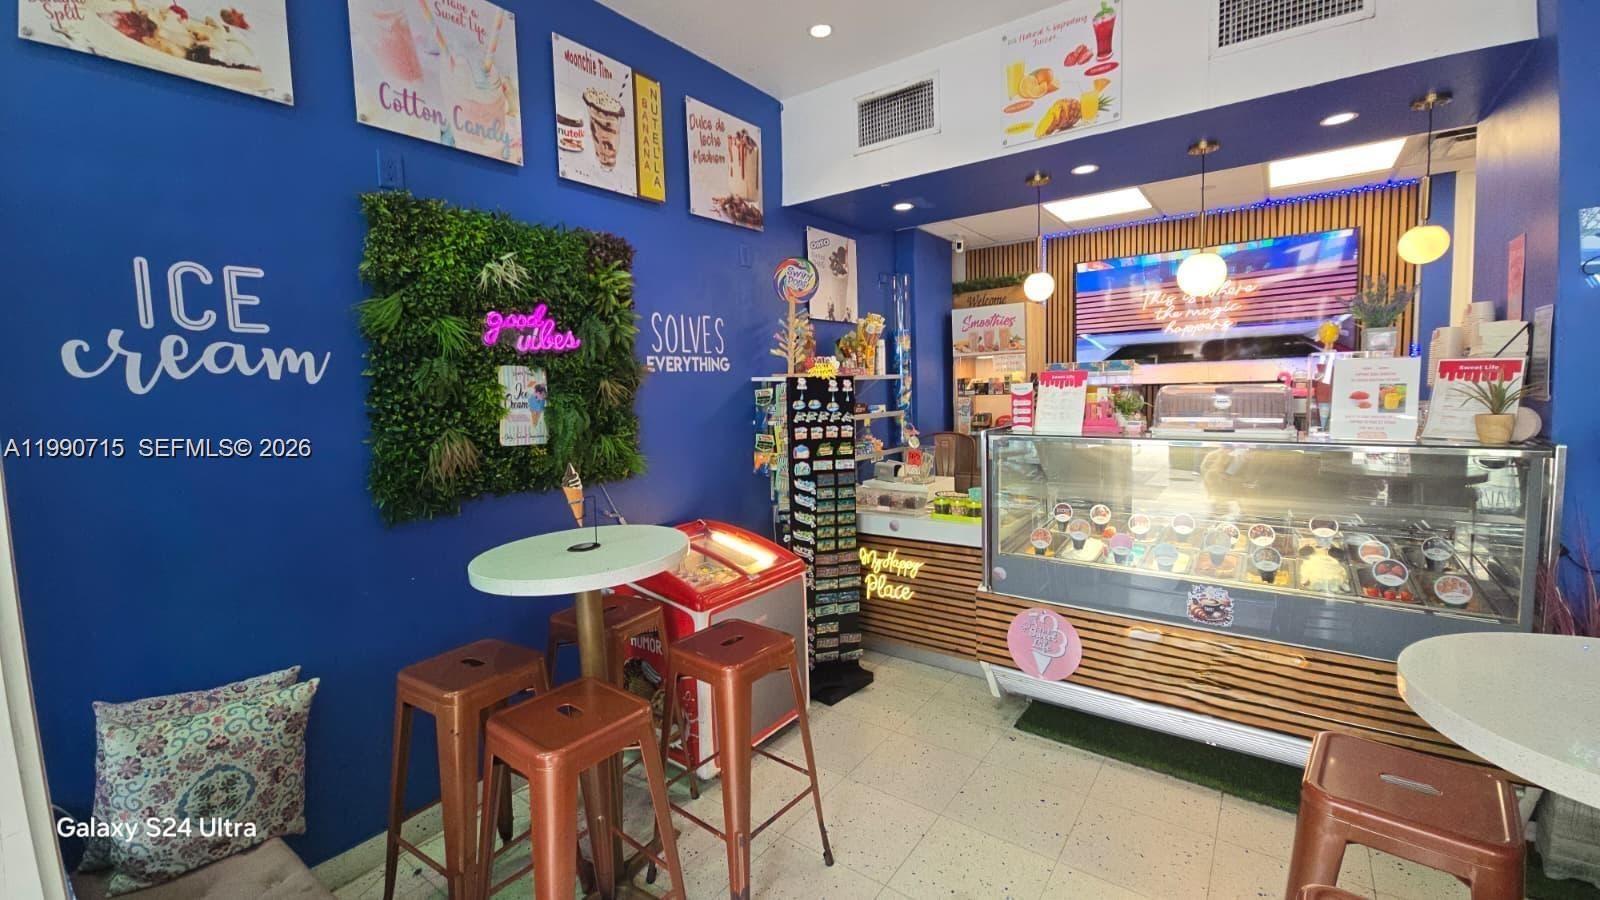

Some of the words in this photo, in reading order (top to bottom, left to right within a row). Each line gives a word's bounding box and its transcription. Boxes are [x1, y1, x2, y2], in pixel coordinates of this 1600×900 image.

[379, 81, 447, 126] Cotton
[453, 105, 513, 160] Candy
[641, 98, 650, 170] BANANA
[689, 113, 712, 130] Dulce
[715, 118, 725, 132] de
[651, 88, 661, 189] NUTELLA
[700, 130, 721, 147] leche
[132, 256, 270, 333] ICE
[966, 294, 1007, 307] Welcome
[1138, 290, 1177, 311] This
[484, 303, 547, 346] good
[962, 313, 1016, 332] Smoothies
[1155, 305, 1183, 320] the
[1185, 301, 1242, 320] magic
[516, 319, 581, 352] vibes
[651, 311, 724, 354] SOLVES
[1164, 320, 1234, 336] happens
[60, 328, 331, 395] cream
[646, 355, 731, 372] EVERYTHING
[859, 547, 881, 574] My
[882, 548, 925, 579] Happy
[864, 573, 915, 600] Place
